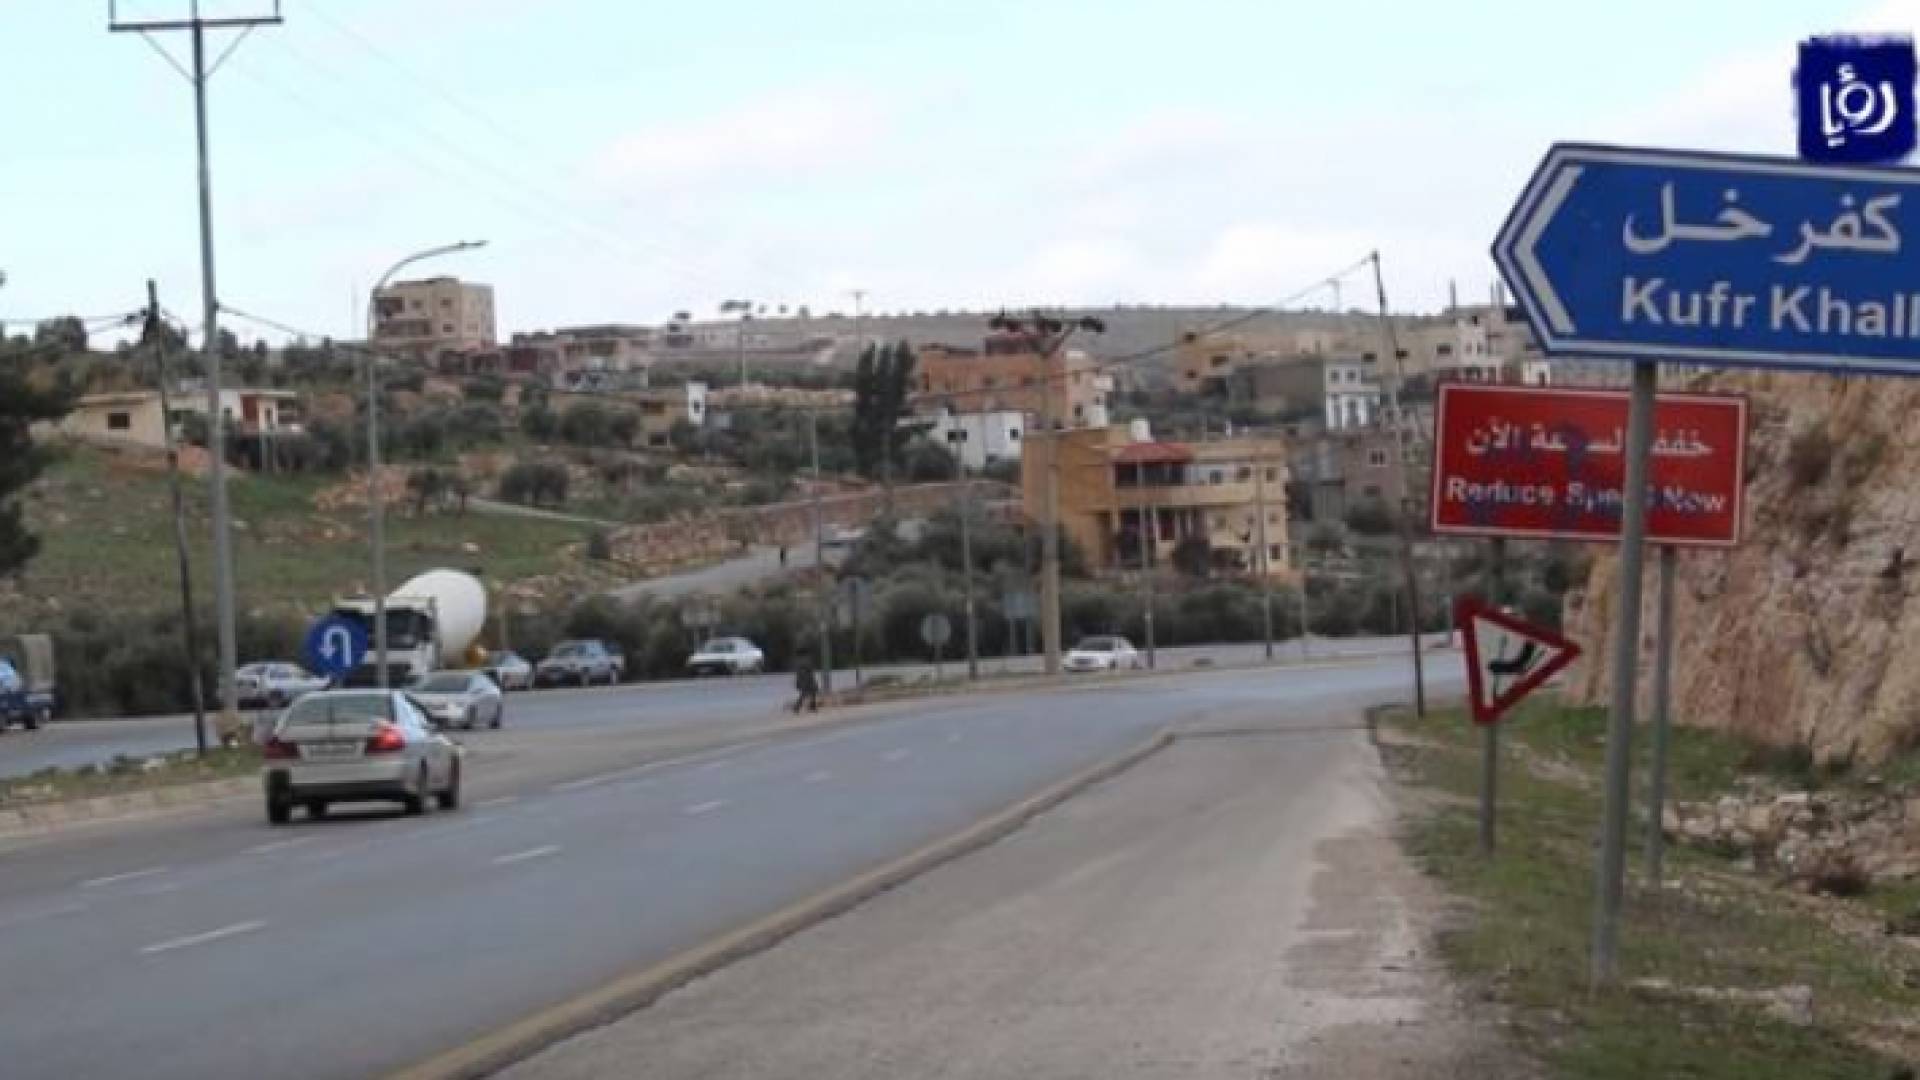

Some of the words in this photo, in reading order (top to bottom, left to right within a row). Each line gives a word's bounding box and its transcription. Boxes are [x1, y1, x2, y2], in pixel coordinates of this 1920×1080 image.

[1622, 181, 1774, 254] خل
[1771, 193, 1901, 264] كفر
[1622, 277, 1757, 330] Kufr
[1770, 284, 1920, 339] Khall
[1447, 477, 1555, 506] Reduce
[1662, 485, 1727, 514] Now
